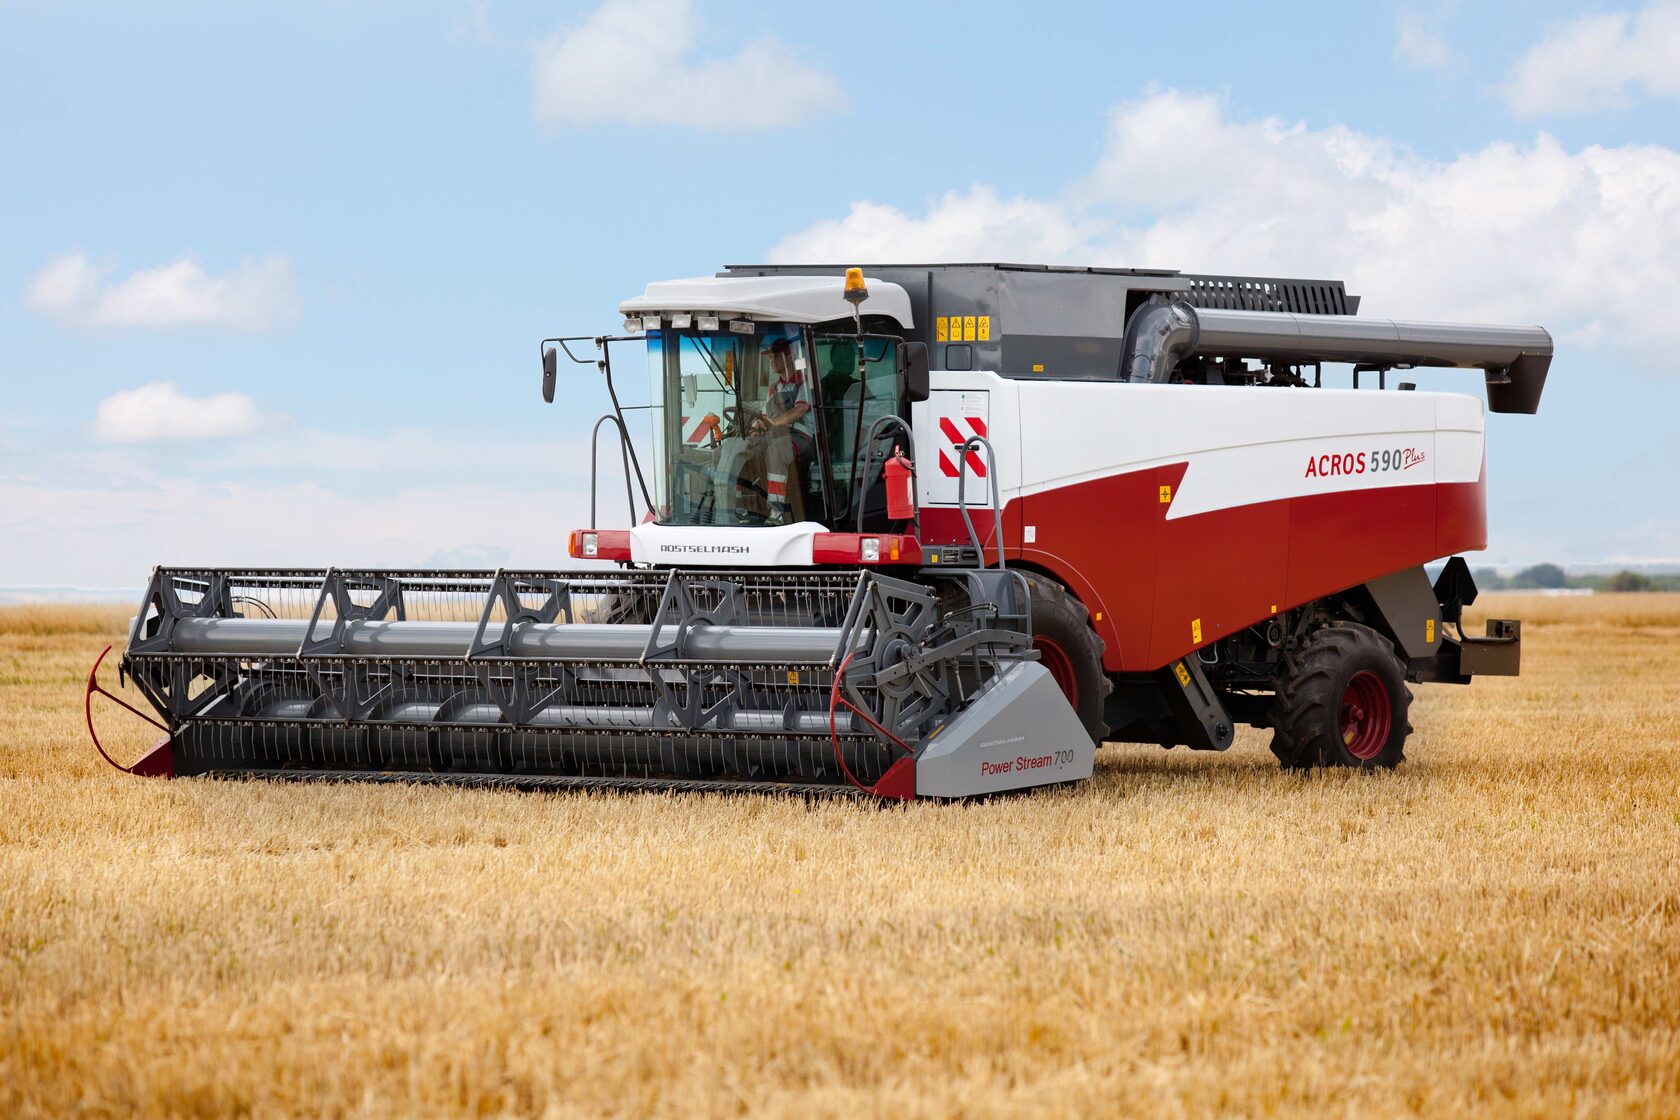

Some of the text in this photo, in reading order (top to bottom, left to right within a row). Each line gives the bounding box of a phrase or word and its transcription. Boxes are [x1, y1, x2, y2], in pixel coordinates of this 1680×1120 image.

[1305, 447, 1426, 478] ACROS 590 Plus
[660, 544, 750, 554] ROSTSELMASH
[981, 749, 1074, 776] Power Stream 700
